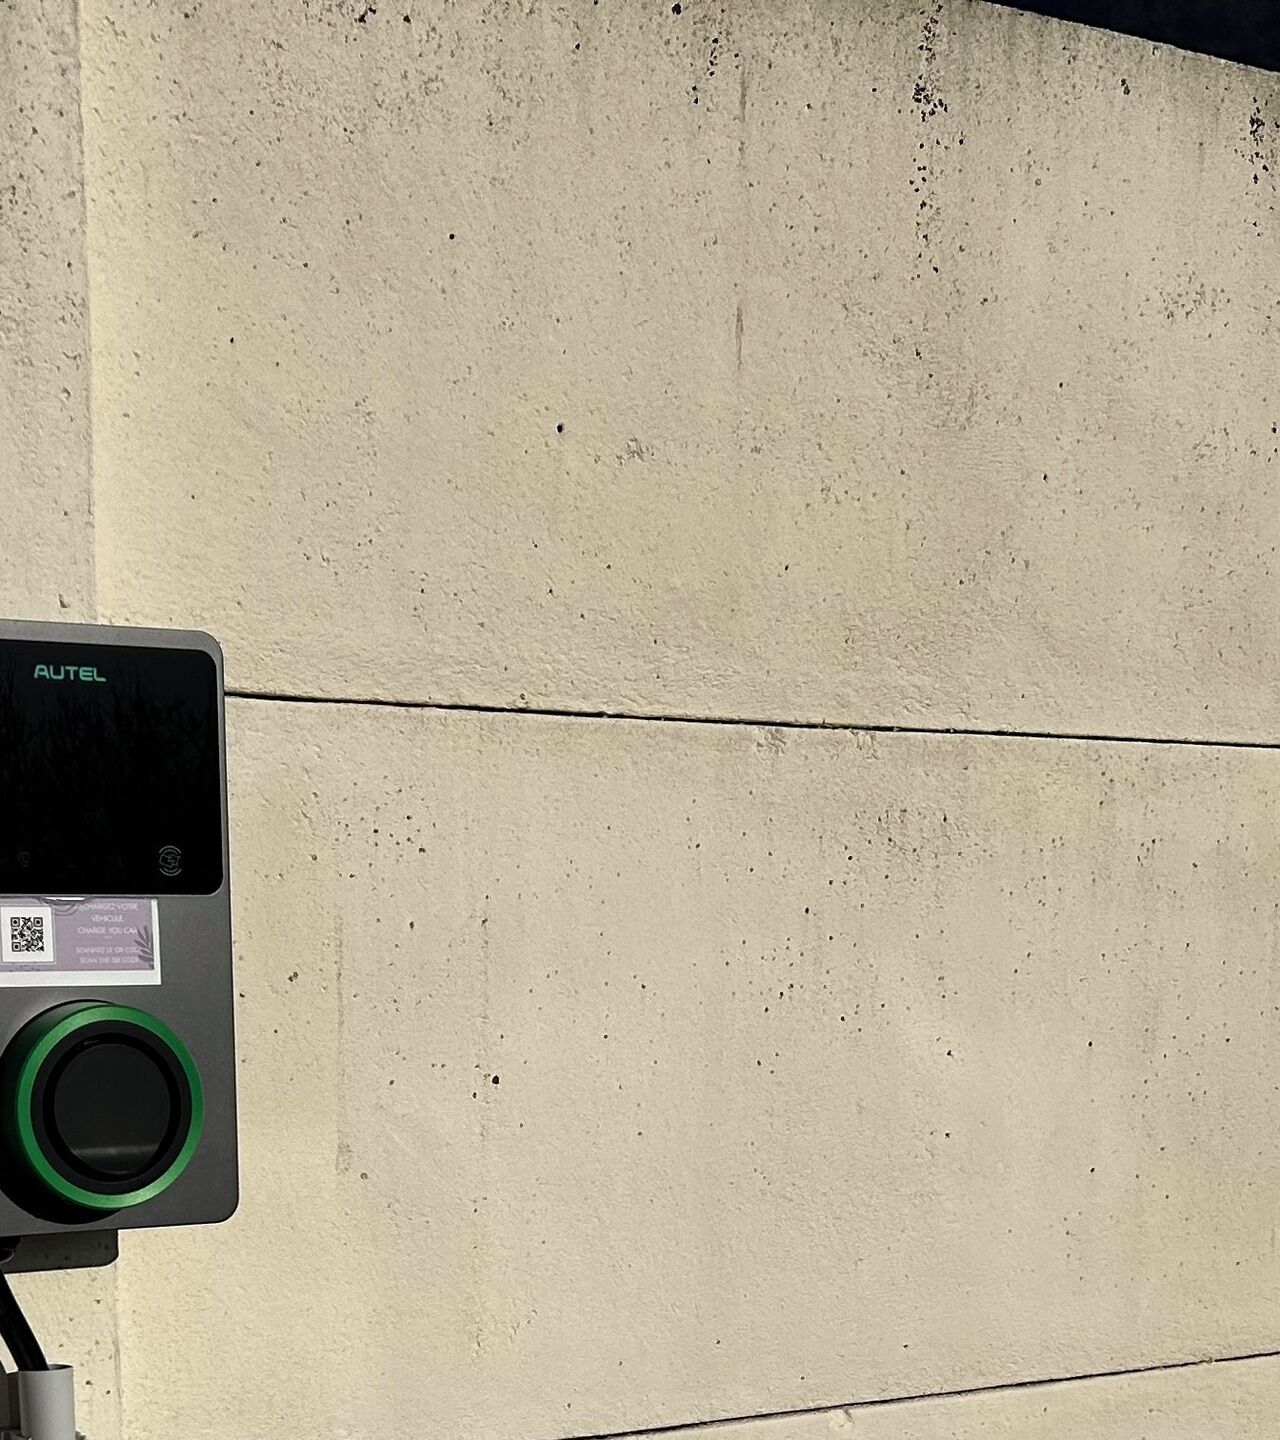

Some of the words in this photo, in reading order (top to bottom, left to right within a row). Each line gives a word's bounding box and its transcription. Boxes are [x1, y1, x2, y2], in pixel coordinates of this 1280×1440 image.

[34, 664, 107, 682] AUTEL
[77, 926, 106, 934] CHARGE
[108, 926, 122, 934] YOU
